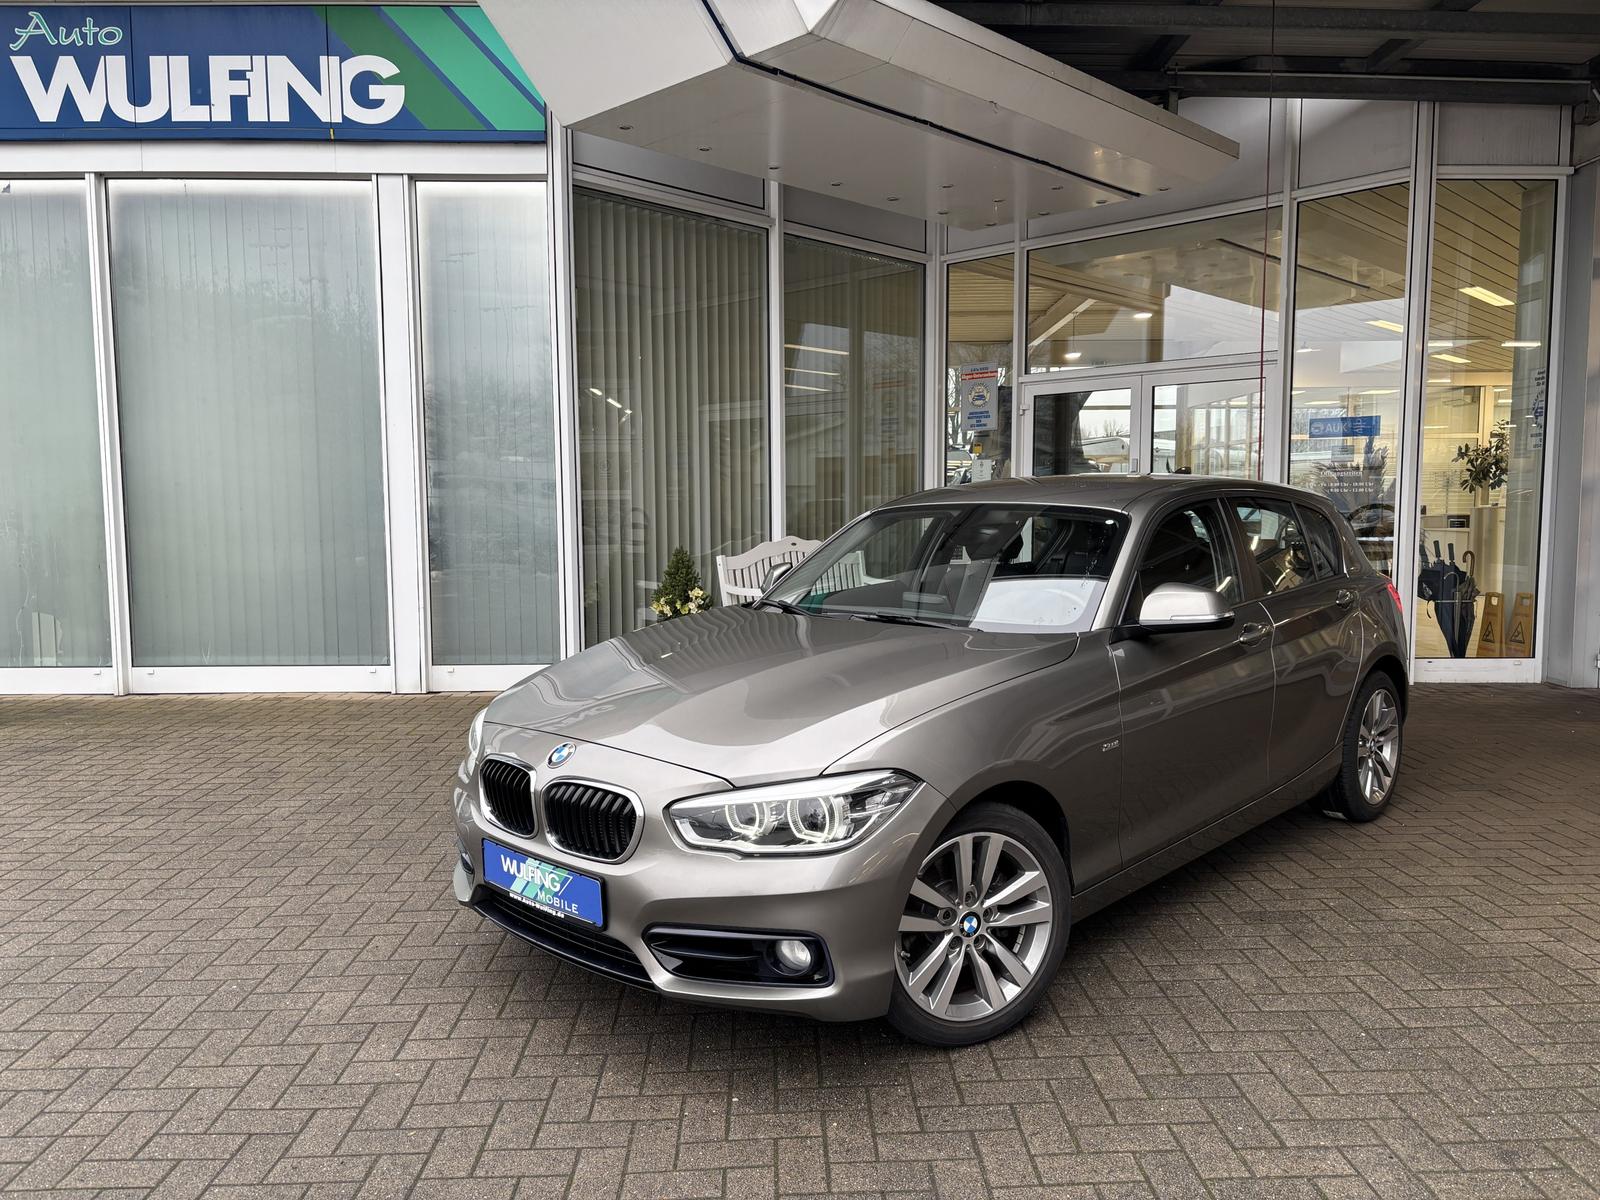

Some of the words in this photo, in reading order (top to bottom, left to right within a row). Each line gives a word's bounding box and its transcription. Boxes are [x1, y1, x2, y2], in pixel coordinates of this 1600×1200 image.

[10, 11, 123, 51] Auto
[10, 55, 405, 124] WULFING
[500, 854, 561, 892] WULFING
[538, 889, 579, 914] MOBILE
